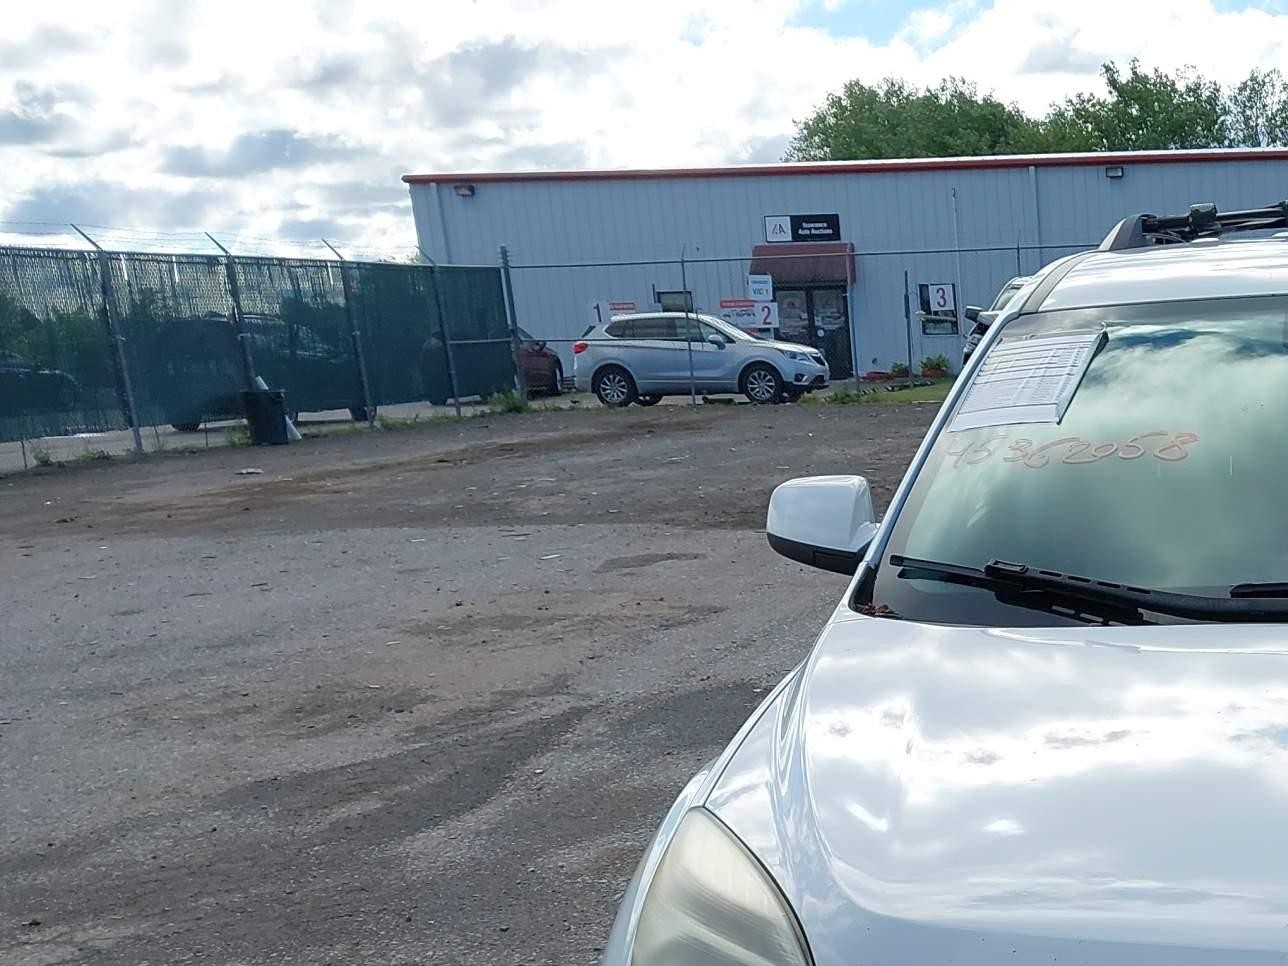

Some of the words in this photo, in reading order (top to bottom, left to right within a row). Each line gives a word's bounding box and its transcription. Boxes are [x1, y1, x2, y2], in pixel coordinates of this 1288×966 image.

[936, 287, 947, 308] 3
[593, 303, 602, 323] 1
[761, 305, 772, 325] 2
